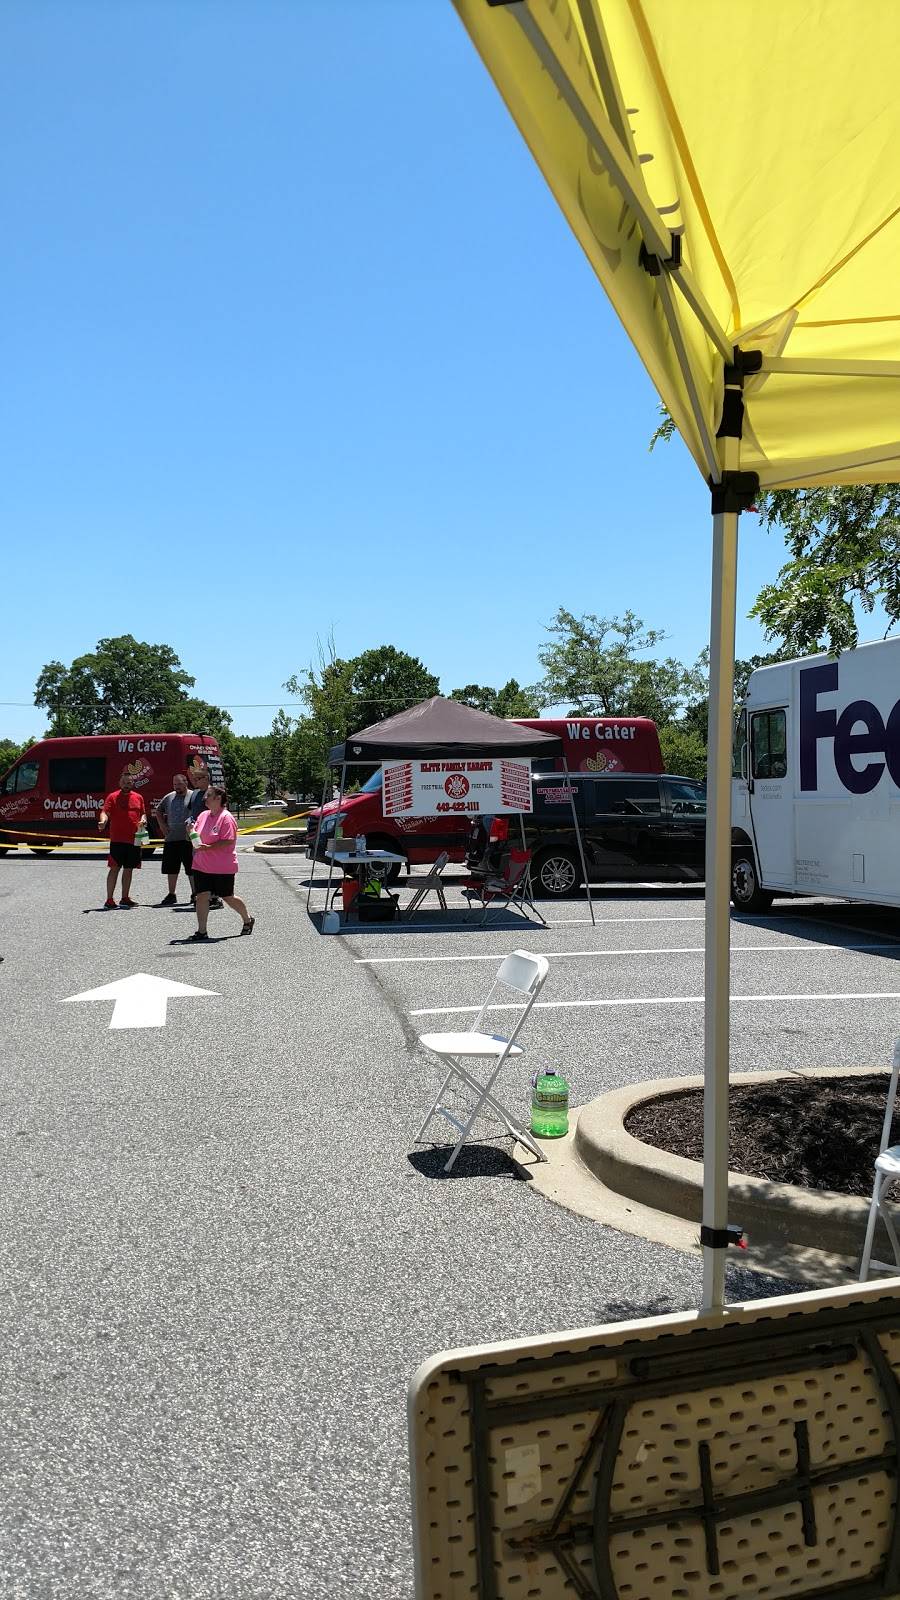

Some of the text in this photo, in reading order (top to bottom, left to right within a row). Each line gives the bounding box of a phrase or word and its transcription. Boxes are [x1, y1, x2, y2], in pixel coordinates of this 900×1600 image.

[566, 723, 636, 740] We Cater
[118, 739, 167, 753] We Cater
[43, 794, 105, 810] Order Online
[53, 810, 96, 819] marcos.com
